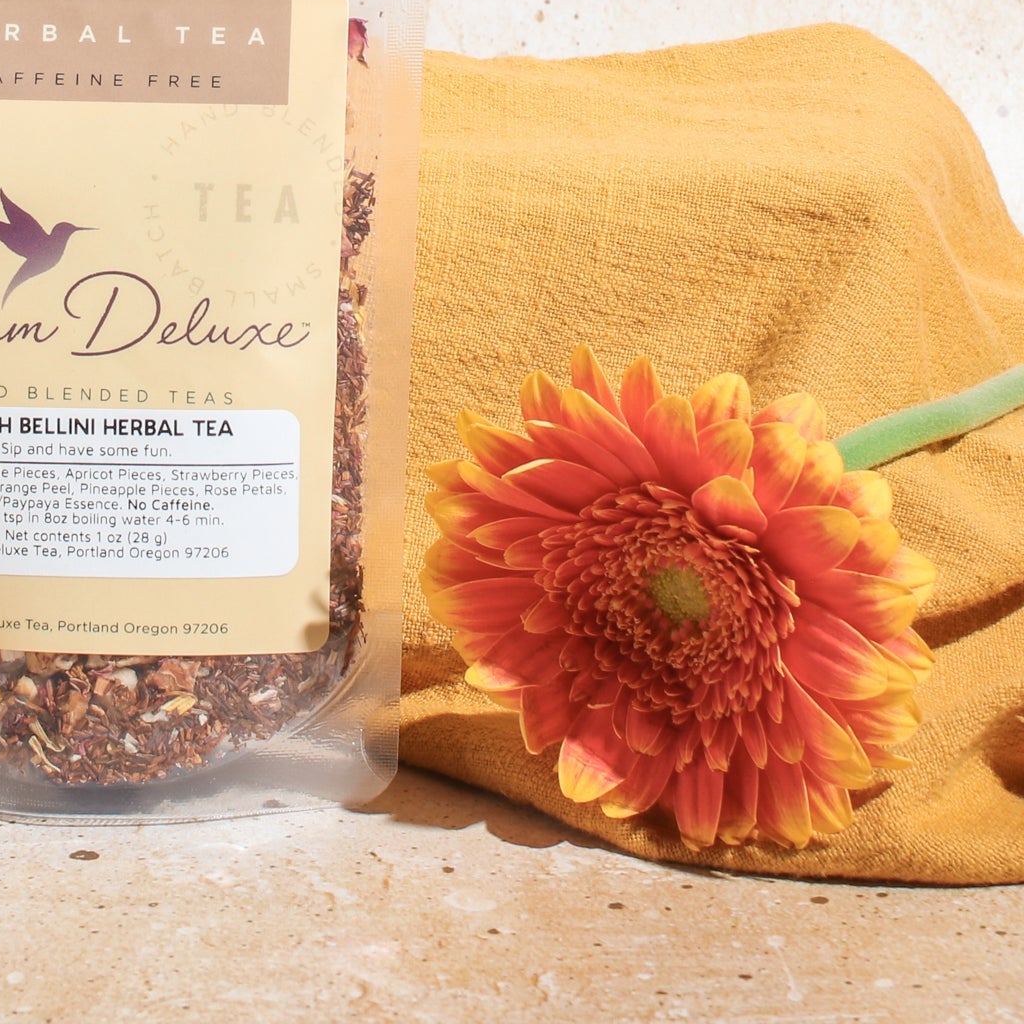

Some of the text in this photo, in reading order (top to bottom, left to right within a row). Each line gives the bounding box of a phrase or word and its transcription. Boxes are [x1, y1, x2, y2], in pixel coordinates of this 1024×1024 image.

[175, 26, 265, 46] TEA
[147, 74, 222, 89] FREE
[160, 103, 238, 158] HAND
[193, 182, 300, 224] TEA
[143, 204, 322, 308] SMALL BATCH
[27, 385, 149, 403] BLENDED
[168, 389, 233, 406] TEAS
[19, 416, 95, 436] BELLINI
[103, 418, 185, 437] HERBAL
[191, 419, 234, 437] TEA
[1, 441, 172, 459] Sip and have some fun.
[13, 466, 61, 480] Pieces,
[65, 467, 113, 483] Apricot
[118, 468, 166, 482] Pieces,
[171, 468, 248, 484] Strawberry
[251, 468, 299, 481] Pieces,
[42, 481, 75, 496] Peel,
[80, 482, 147, 499] Pineapple
[151, 483, 199, 498] Pieces,
[204, 484, 238, 497] Rose
[242, 483, 287, 496] Petals,
[64, 497, 123, 511] Essence.
[127, 498, 147, 511] No
[151, 498, 214, 512] Caffeine.
[3, 511, 24, 526] tsp
[28, 511, 40, 524] in
[44, 511, 68, 525] 8oz
[72, 511, 117, 529] boiling
[121, 514, 161, 526] water
[165, 513, 190, 526] 4-6
[195, 514, 225, 526] min.
[5, 529, 28, 542] Net
[33, 530, 92, 543] contents
[106, 533, 123, 544] oz
[127, 531, 150, 545] (28
[154, 531, 168, 547] g)
[32, 544, 62, 559] Tea,
[67, 545, 125, 559] Portland
[129, 546, 180, 562] Oregon
[184, 546, 229, 559] 97206
[24, 618, 53, 633] Tea,
[57, 620, 119, 634] Portland
[123, 622, 178, 637] Oregon
[182, 622, 229, 635] 97206
